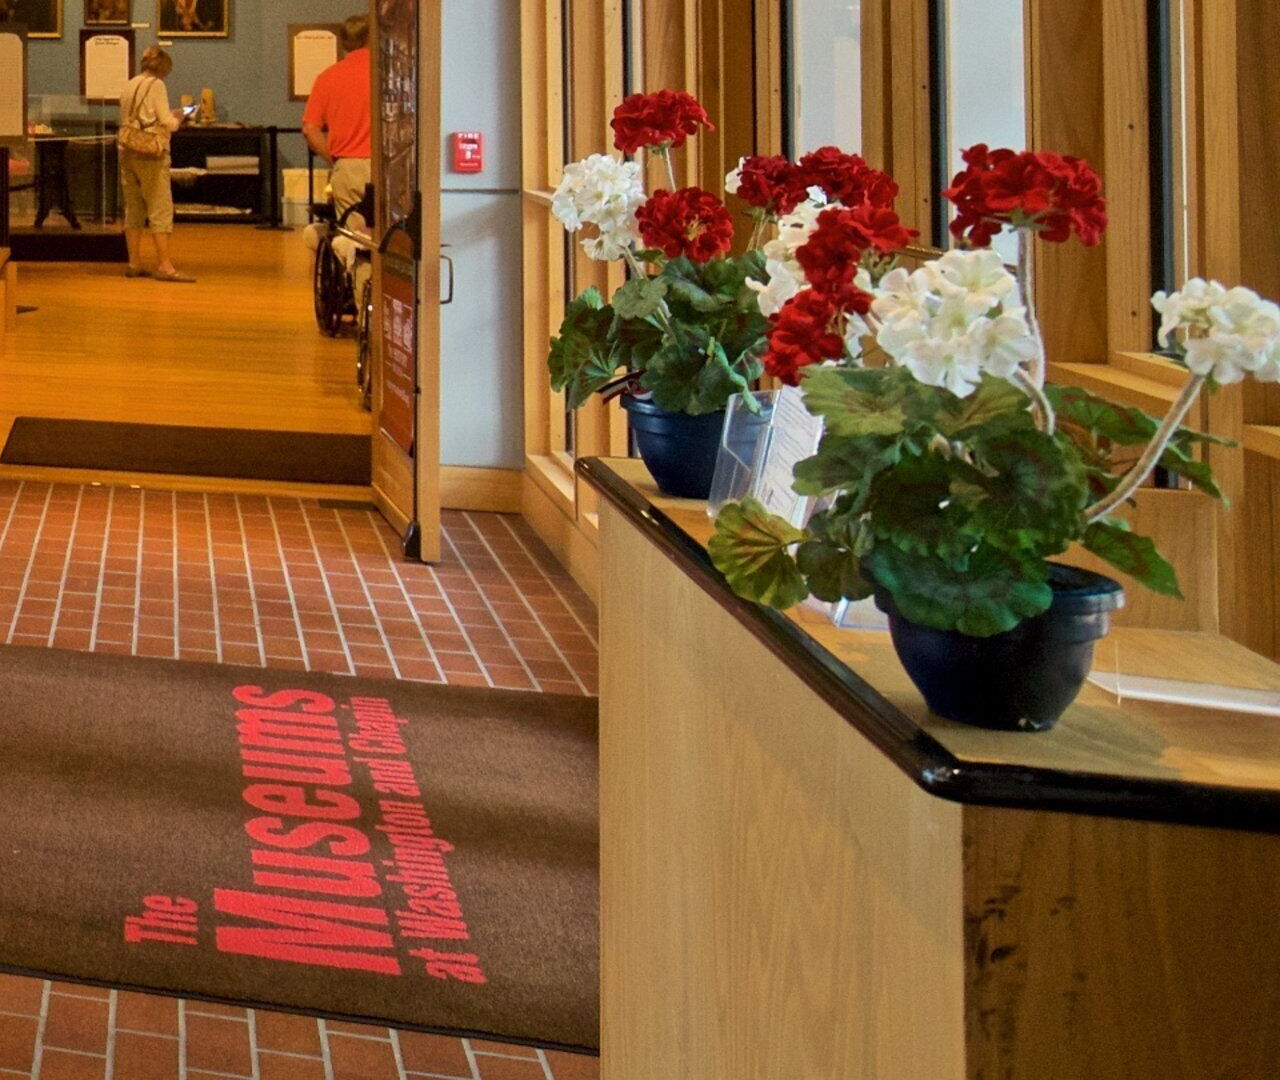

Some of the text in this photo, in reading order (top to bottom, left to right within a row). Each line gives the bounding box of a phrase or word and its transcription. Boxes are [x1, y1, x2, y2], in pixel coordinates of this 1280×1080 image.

[124, 894, 199, 946] The
[213, 684, 402, 977] Museums
[340, 695, 488, 984] at Washington and Chapin
